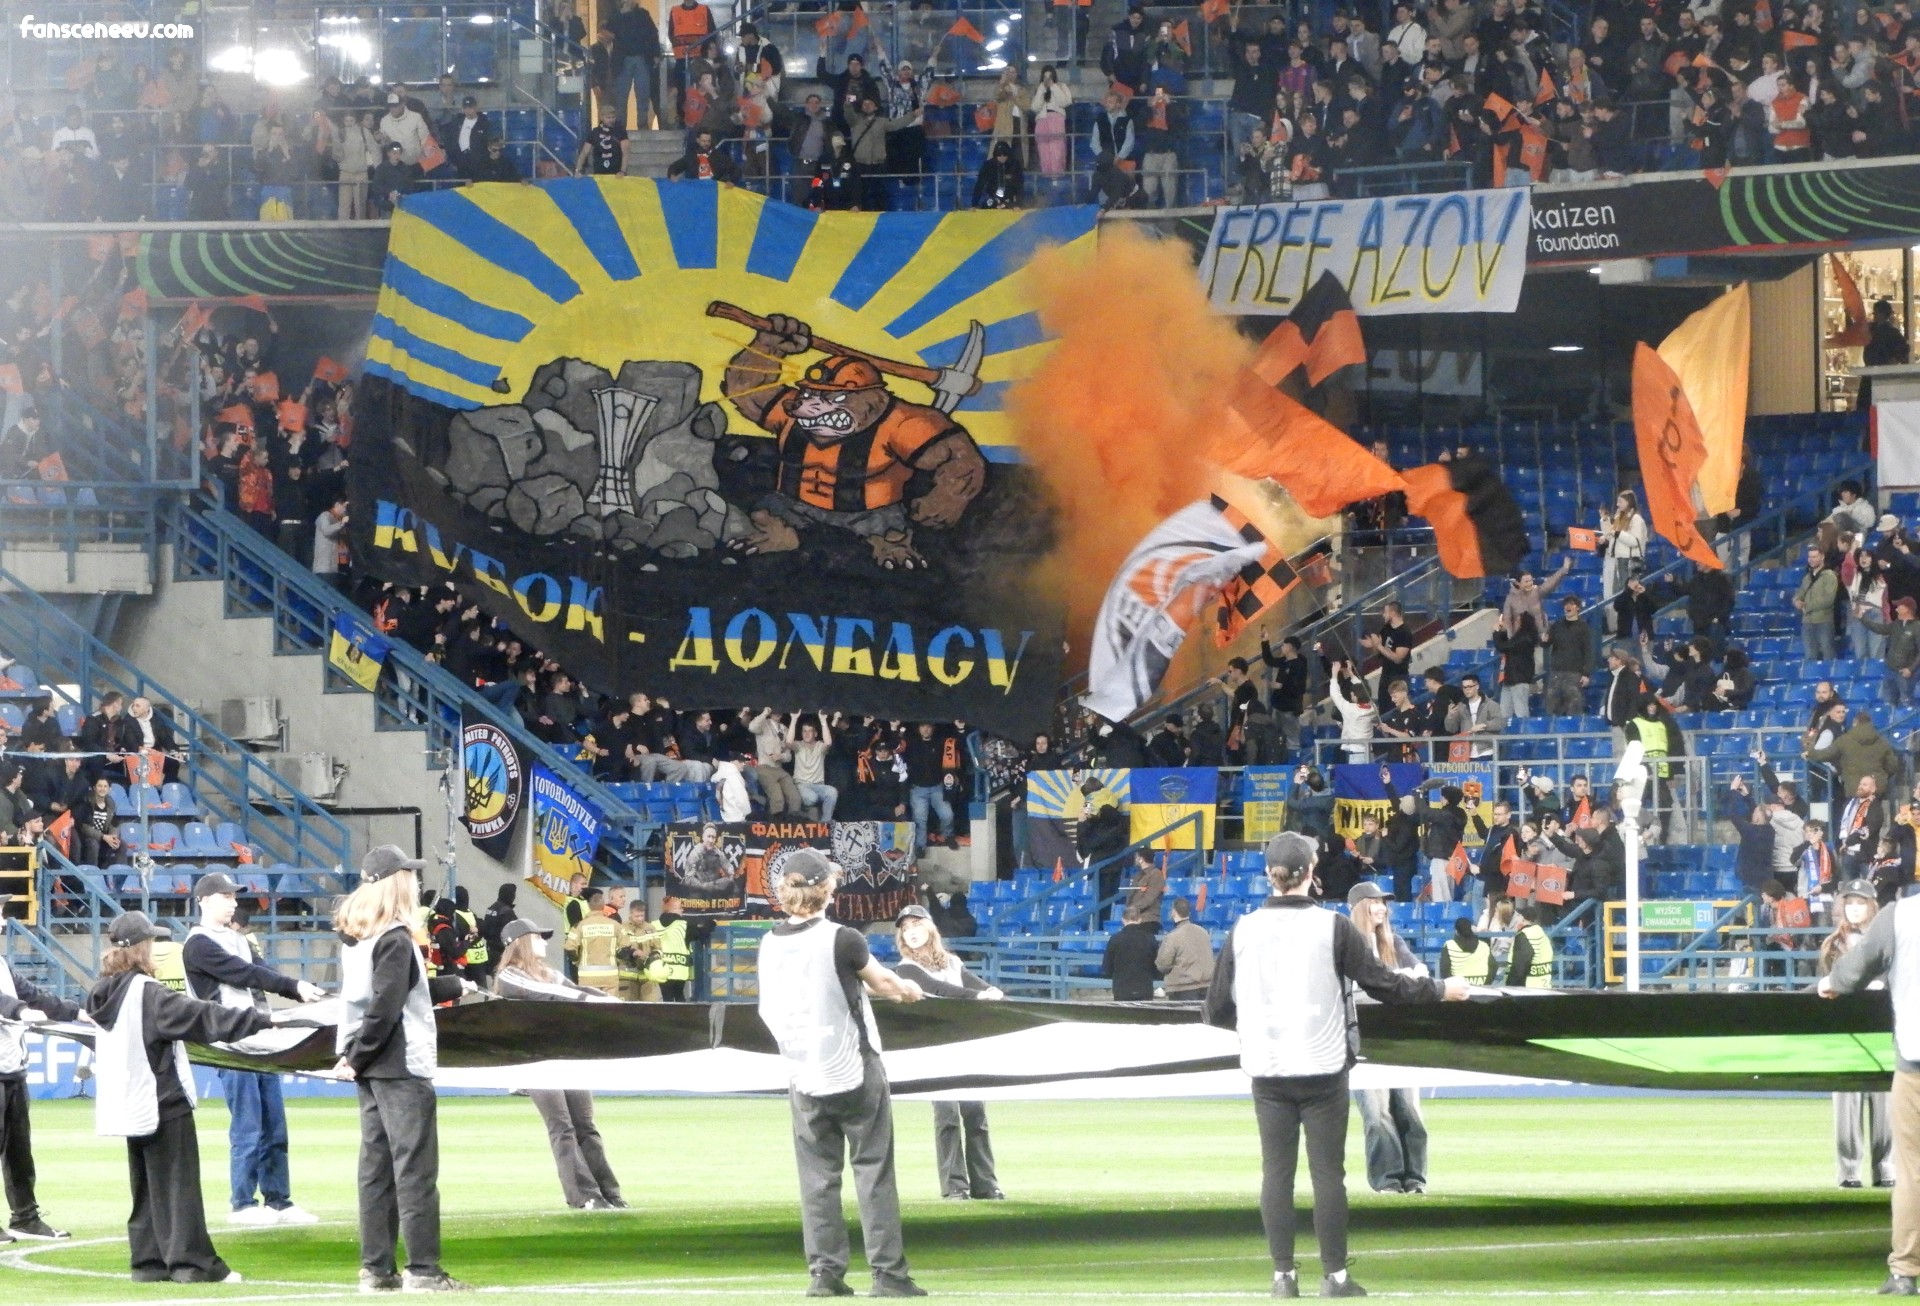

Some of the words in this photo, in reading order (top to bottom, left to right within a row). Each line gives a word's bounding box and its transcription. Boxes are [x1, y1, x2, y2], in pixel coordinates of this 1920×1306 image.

[1530, 202, 1616, 230] kaizen
[1207, 203, 1344, 305] FREE
[1348, 191, 1526, 305] AZOV
[1536, 231, 1620, 253] foundation
[464, 728, 489, 744] NITED
[751, 822, 829, 839] ФАНАТИ
[1645, 917, 1692, 926] EWAKUACYJNE
[1696, 910, 1712, 922] E11
[662, 953, 687, 965] WARD
[1530, 964, 1552, 976] STEW
